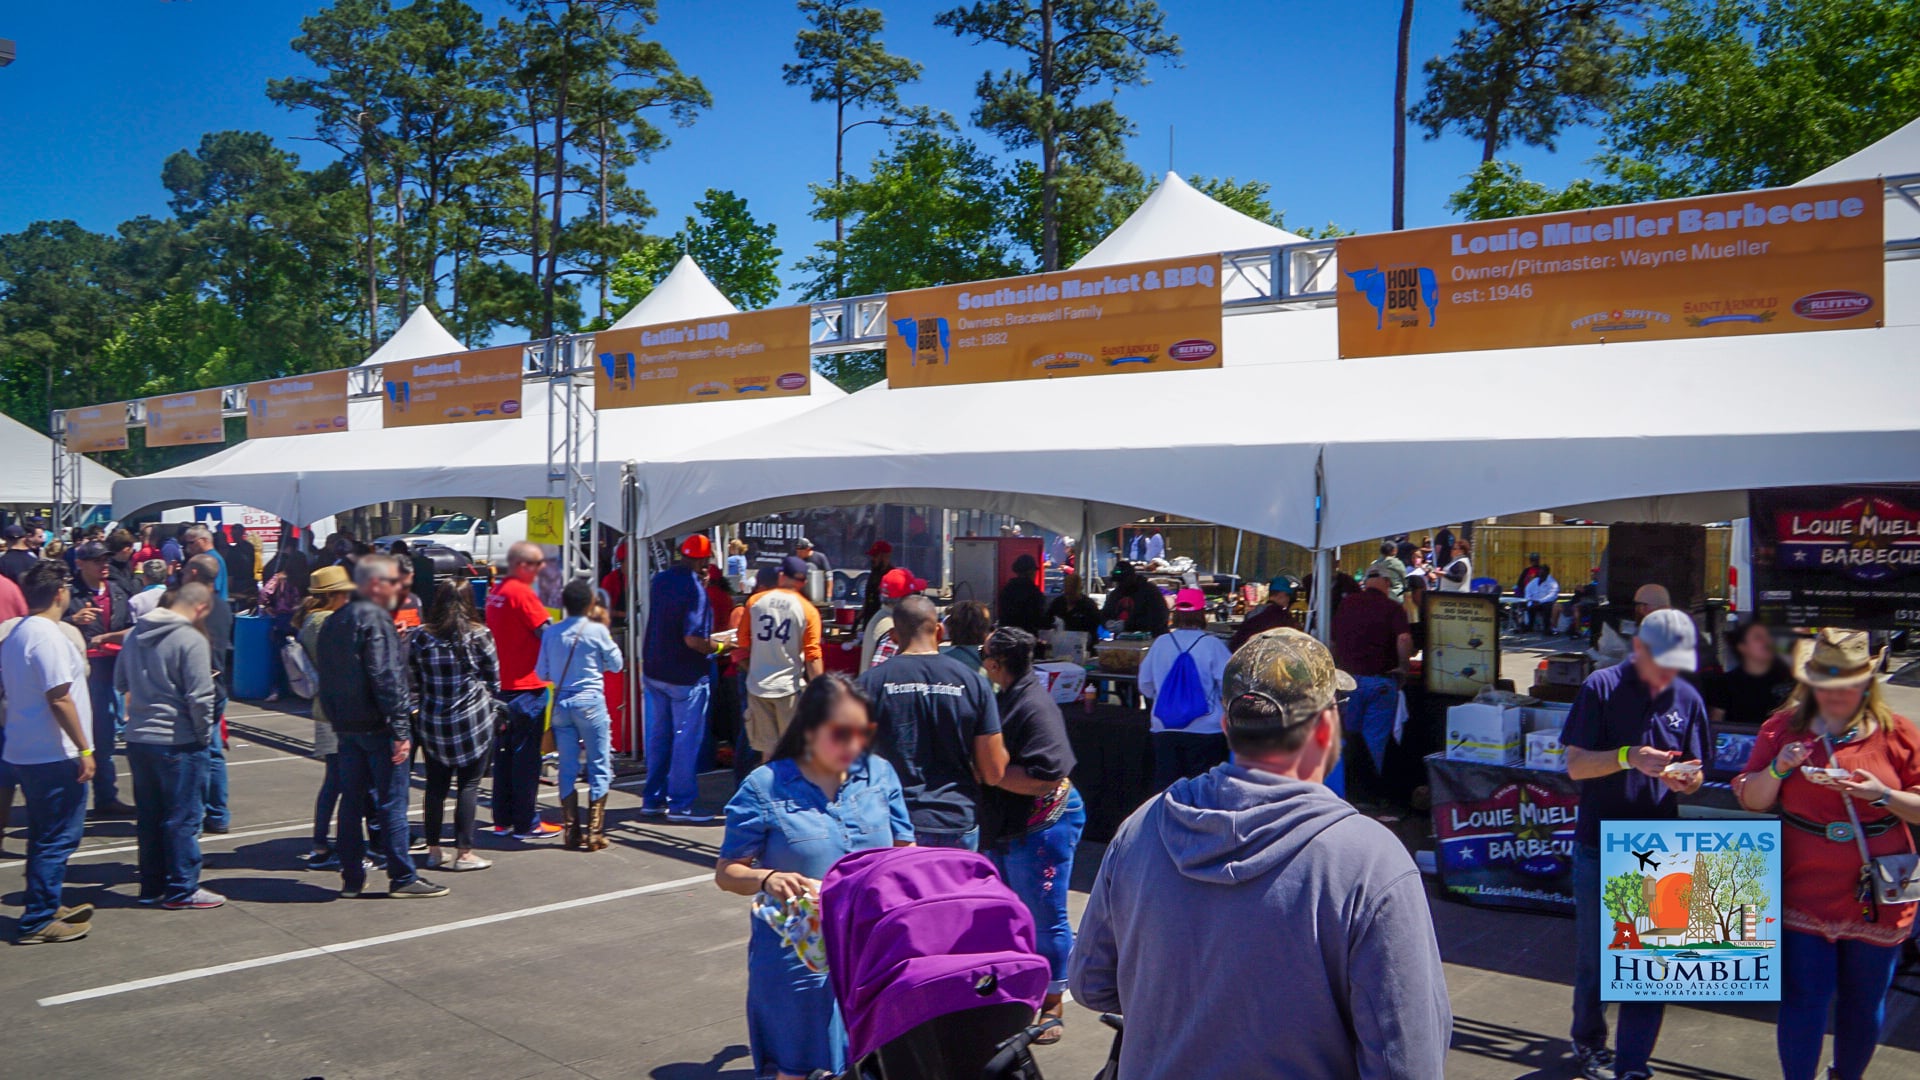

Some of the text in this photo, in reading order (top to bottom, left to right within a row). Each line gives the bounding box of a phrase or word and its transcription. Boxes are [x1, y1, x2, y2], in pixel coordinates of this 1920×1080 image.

[1451, 197, 1865, 256] Louie Mueller Barbecue
[1451, 240, 1771, 282] Owner/Pitmaster: Wayne Mueller
[957, 265, 1215, 310] Southside Market & BBQ
[1387, 268, 1418, 289] HOU
[1388, 289, 1418, 311] BBQ
[1452, 283, 1533, 304] est: 1946
[1683, 296, 1778, 314] SAINT ARNOLD
[957, 304, 1103, 331] Owners: Bracewell Family
[641, 321, 730, 347] Gatlin's BBQ
[957, 332, 1008, 348] est: 1882
[1792, 516, 1854, 535] LOUIE
[757, 614, 791, 645] 34
[1451, 808, 1514, 831] LOUIE
